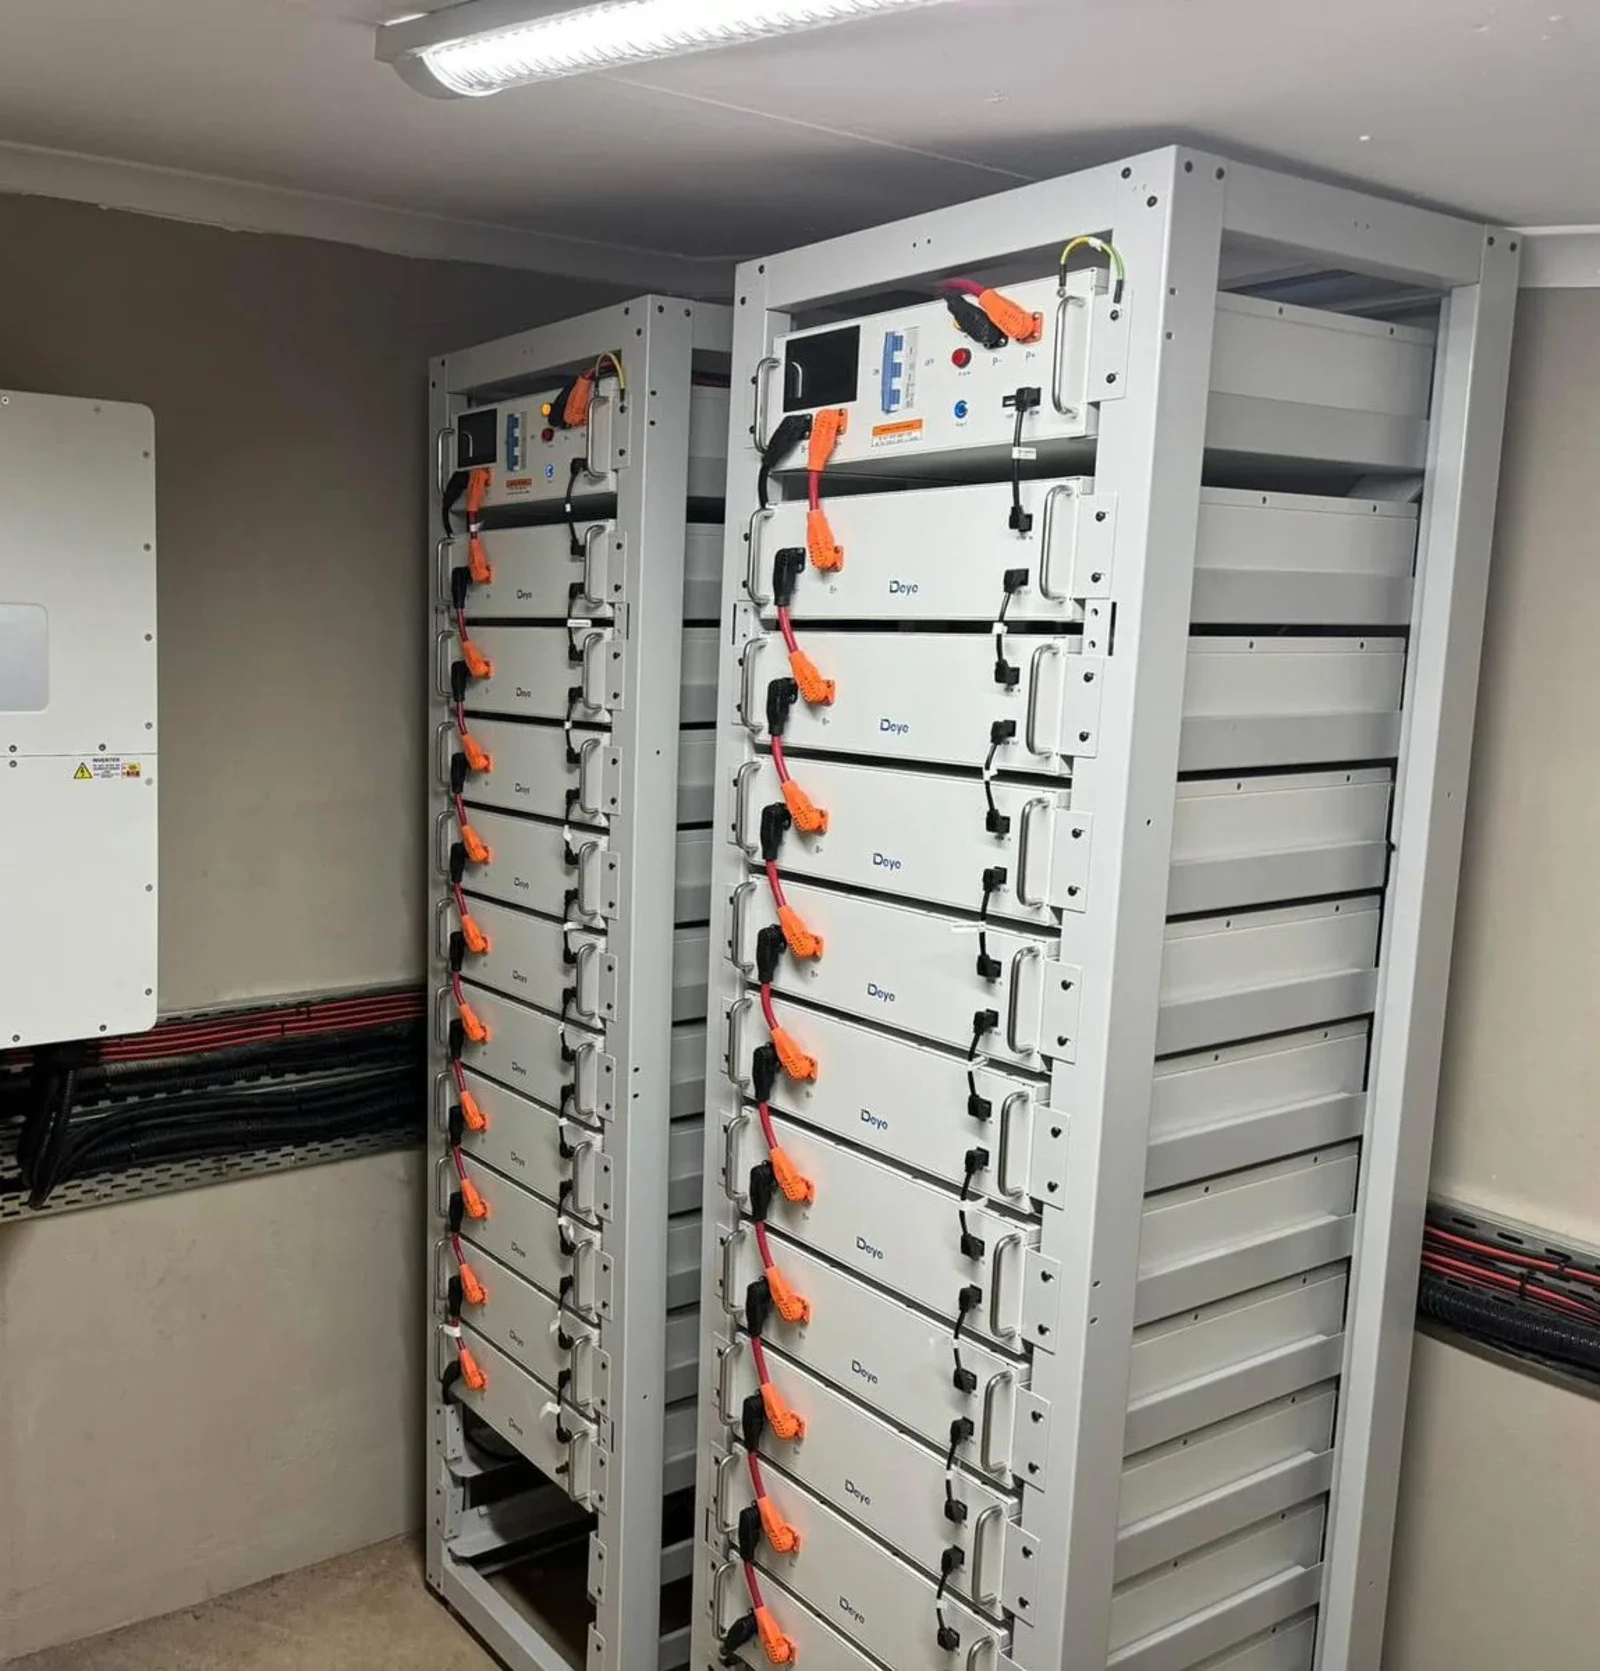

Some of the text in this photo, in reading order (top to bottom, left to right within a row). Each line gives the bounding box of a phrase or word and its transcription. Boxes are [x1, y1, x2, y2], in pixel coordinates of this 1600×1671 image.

[890, 580, 918, 596] Deye
[880, 719, 909, 735] Deye
[873, 853, 901, 871] Deye
[867, 983, 895, 1003] Deye
[861, 1109, 888, 1130] Deye
[857, 1236, 883, 1260] Deye
